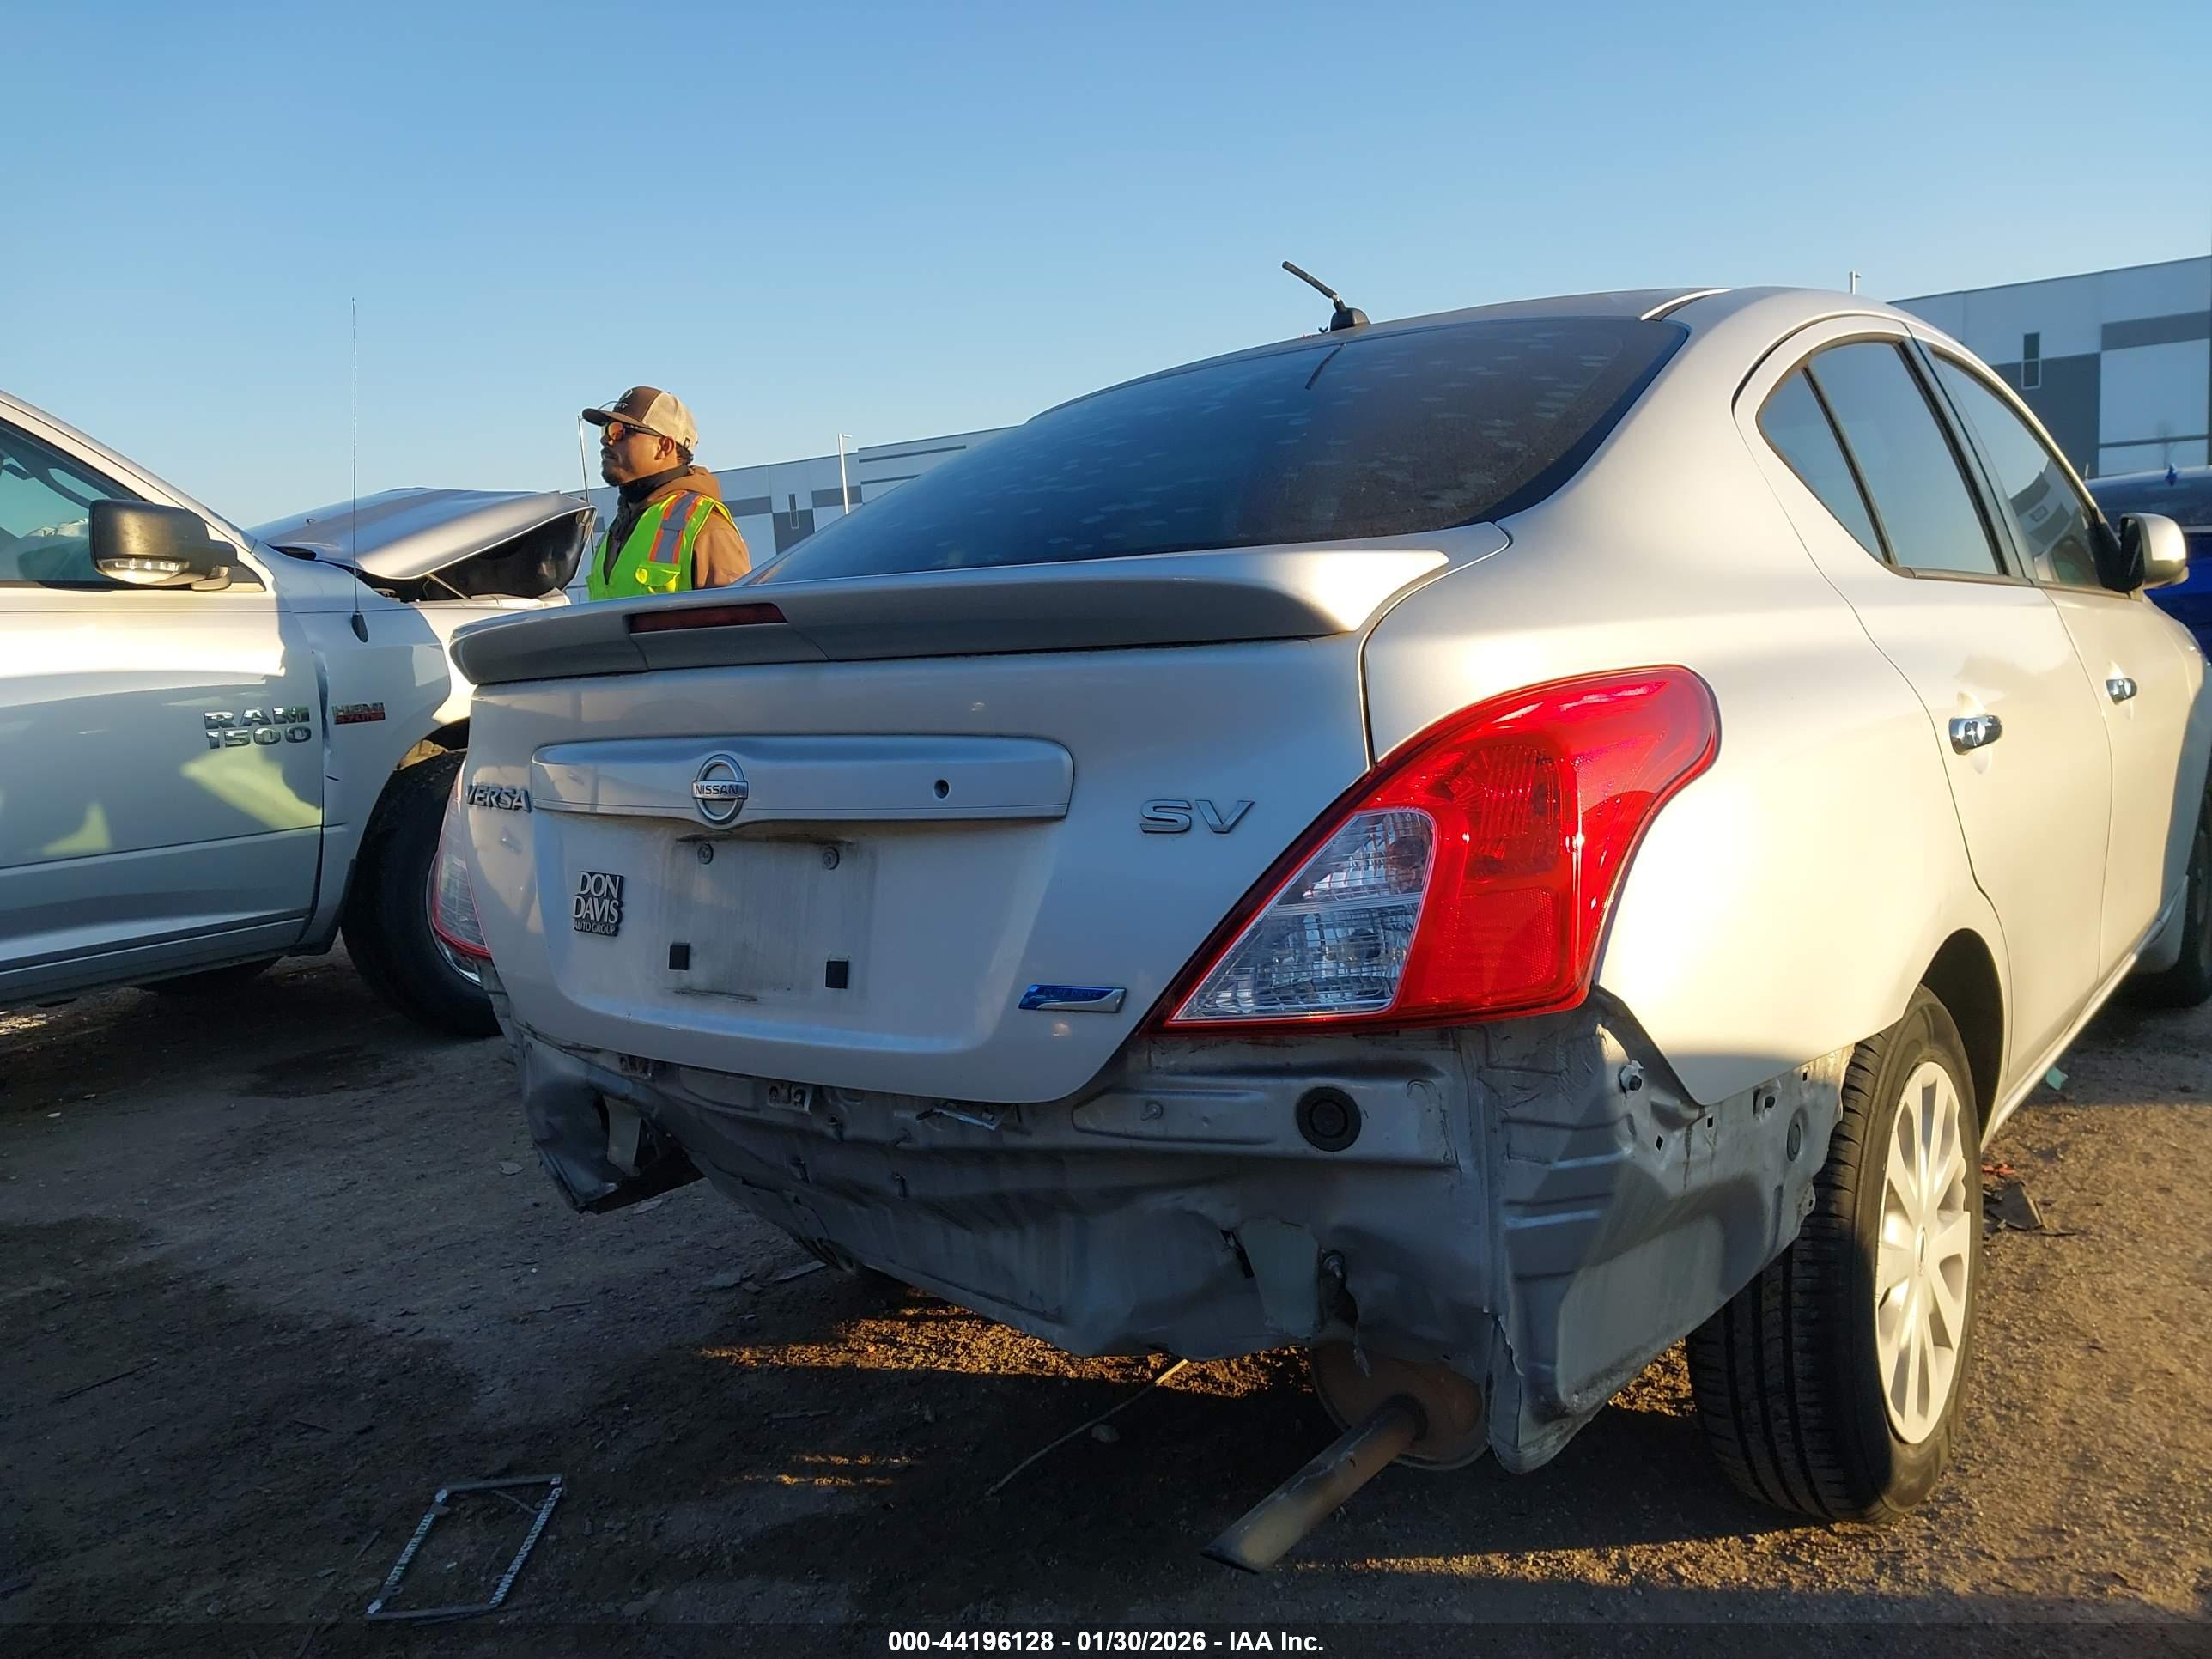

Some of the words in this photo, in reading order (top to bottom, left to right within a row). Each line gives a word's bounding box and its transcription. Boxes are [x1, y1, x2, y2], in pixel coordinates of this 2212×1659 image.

[204, 707, 310, 729] RAM
[331, 702, 385, 715] HEMI
[206, 726, 312, 749] 1500
[467, 784, 532, 813] VERSA
[695, 784, 738, 795] NISSAN
[1139, 799, 1255, 834] SV
[576, 872, 620, 899] DON
[573, 896, 619, 924] DAVIS
[574, 919, 591, 932] AUTO
[592, 922, 616, 934] GROUP
[1043, 988, 1066, 998] PURE
[1071, 989, 1101, 998] DRIVE
